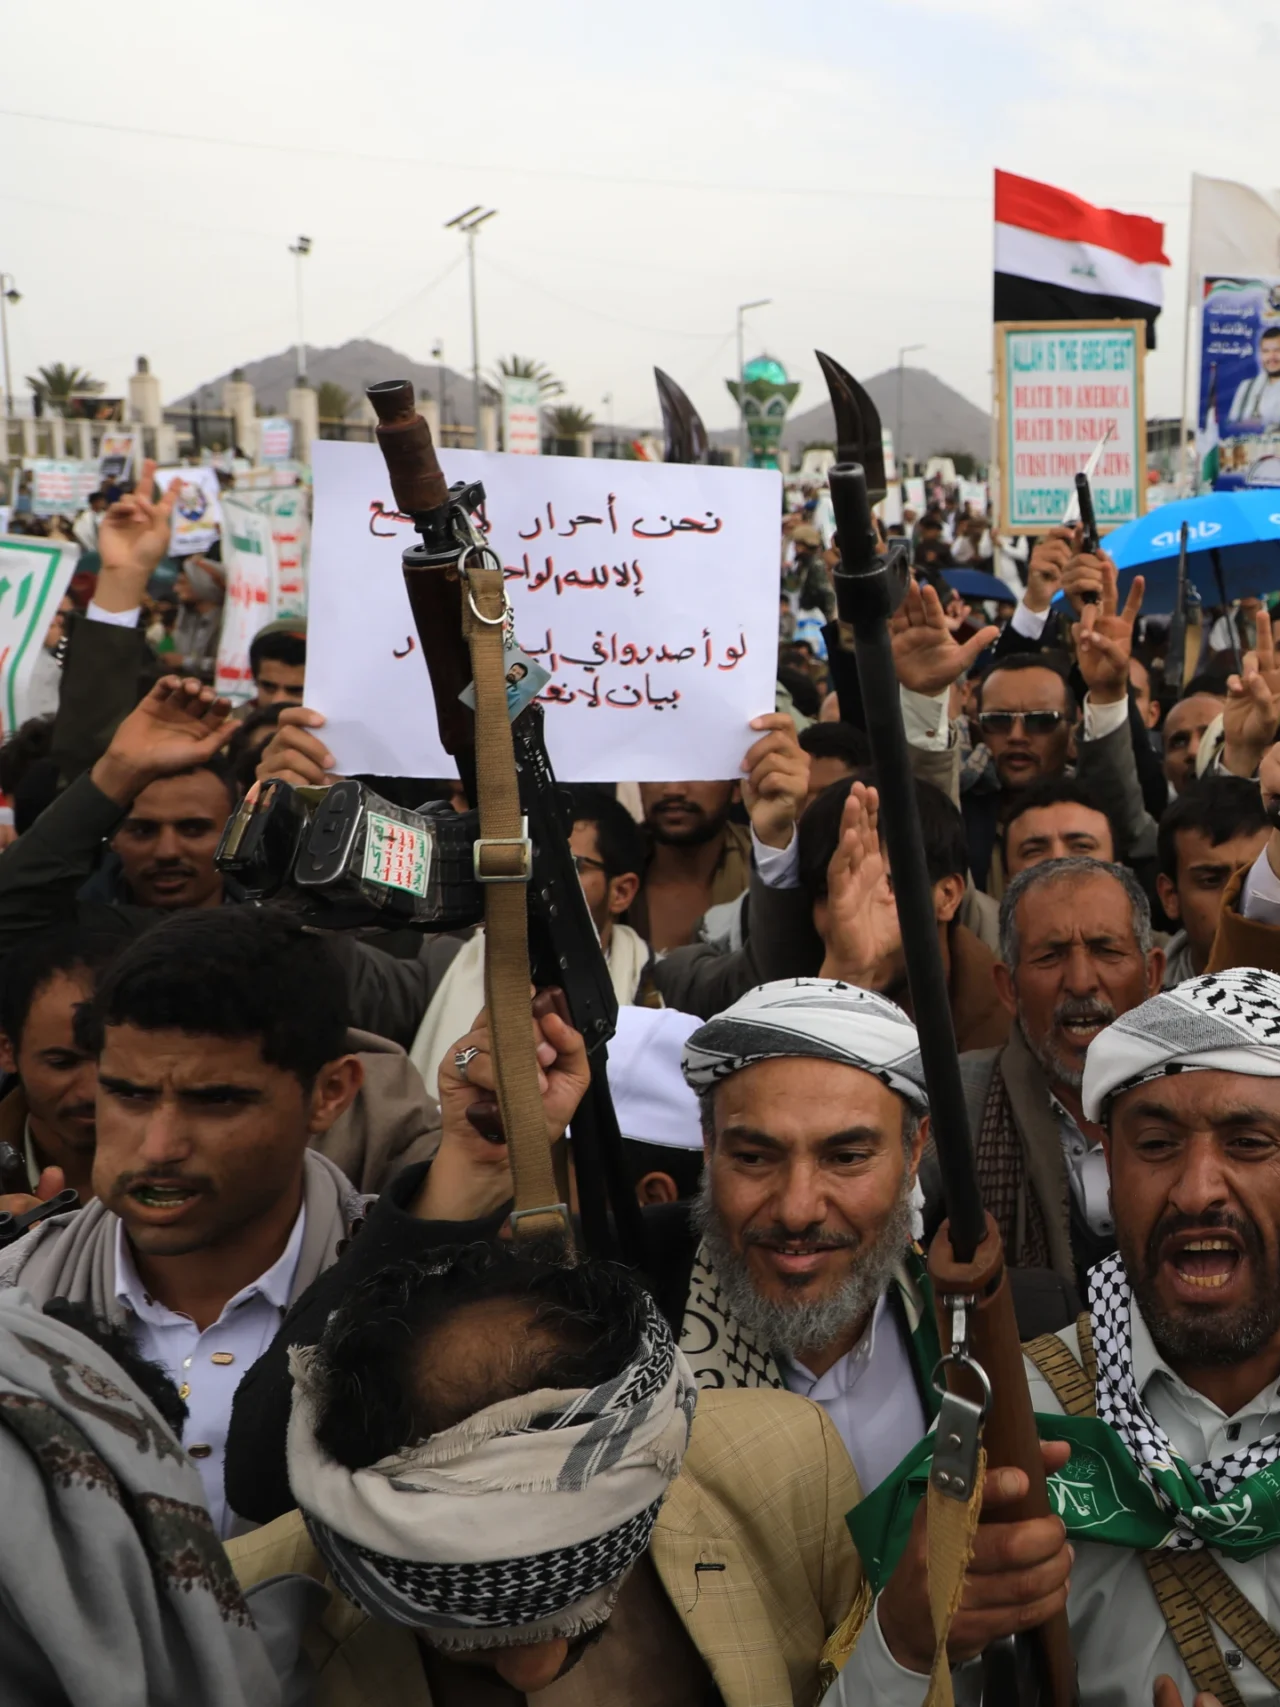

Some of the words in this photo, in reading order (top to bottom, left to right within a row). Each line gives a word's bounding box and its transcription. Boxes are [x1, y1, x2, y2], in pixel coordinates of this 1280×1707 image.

[1013, 340, 1043, 371] ALLAH
[1047, 340, 1056, 371] IS
[1058, 340, 1078, 371] THE
[1081, 339, 1133, 371] GREATEST
[1015, 385, 1053, 409] DEATH
[1056, 385, 1073, 409] TO
[1076, 385, 1129, 409] AMERICA
[1015, 418, 1053, 441] DEATH
[1057, 418, 1073, 441] TO
[1076, 418, 1119, 441] ISRAEL
[1015, 453, 1047, 476] CURSE
[1050, 453, 1076, 476] UPON
[1101, 453, 1130, 476] JEWS
[519, 492, 619, 541] أحرار
[632, 509, 722, 540] نحن
[566, 562, 610, 590] لله
[613, 558, 646, 597] إلا
[559, 630, 607, 673] في
[611, 627, 713, 667] أصدروا
[717, 630, 748, 671] لو
[578, 673, 602, 708] لا
[605, 673, 683, 711] بيان
[371, 842, 382, 879] أكبر
[415, 833, 425, 861] النصر
